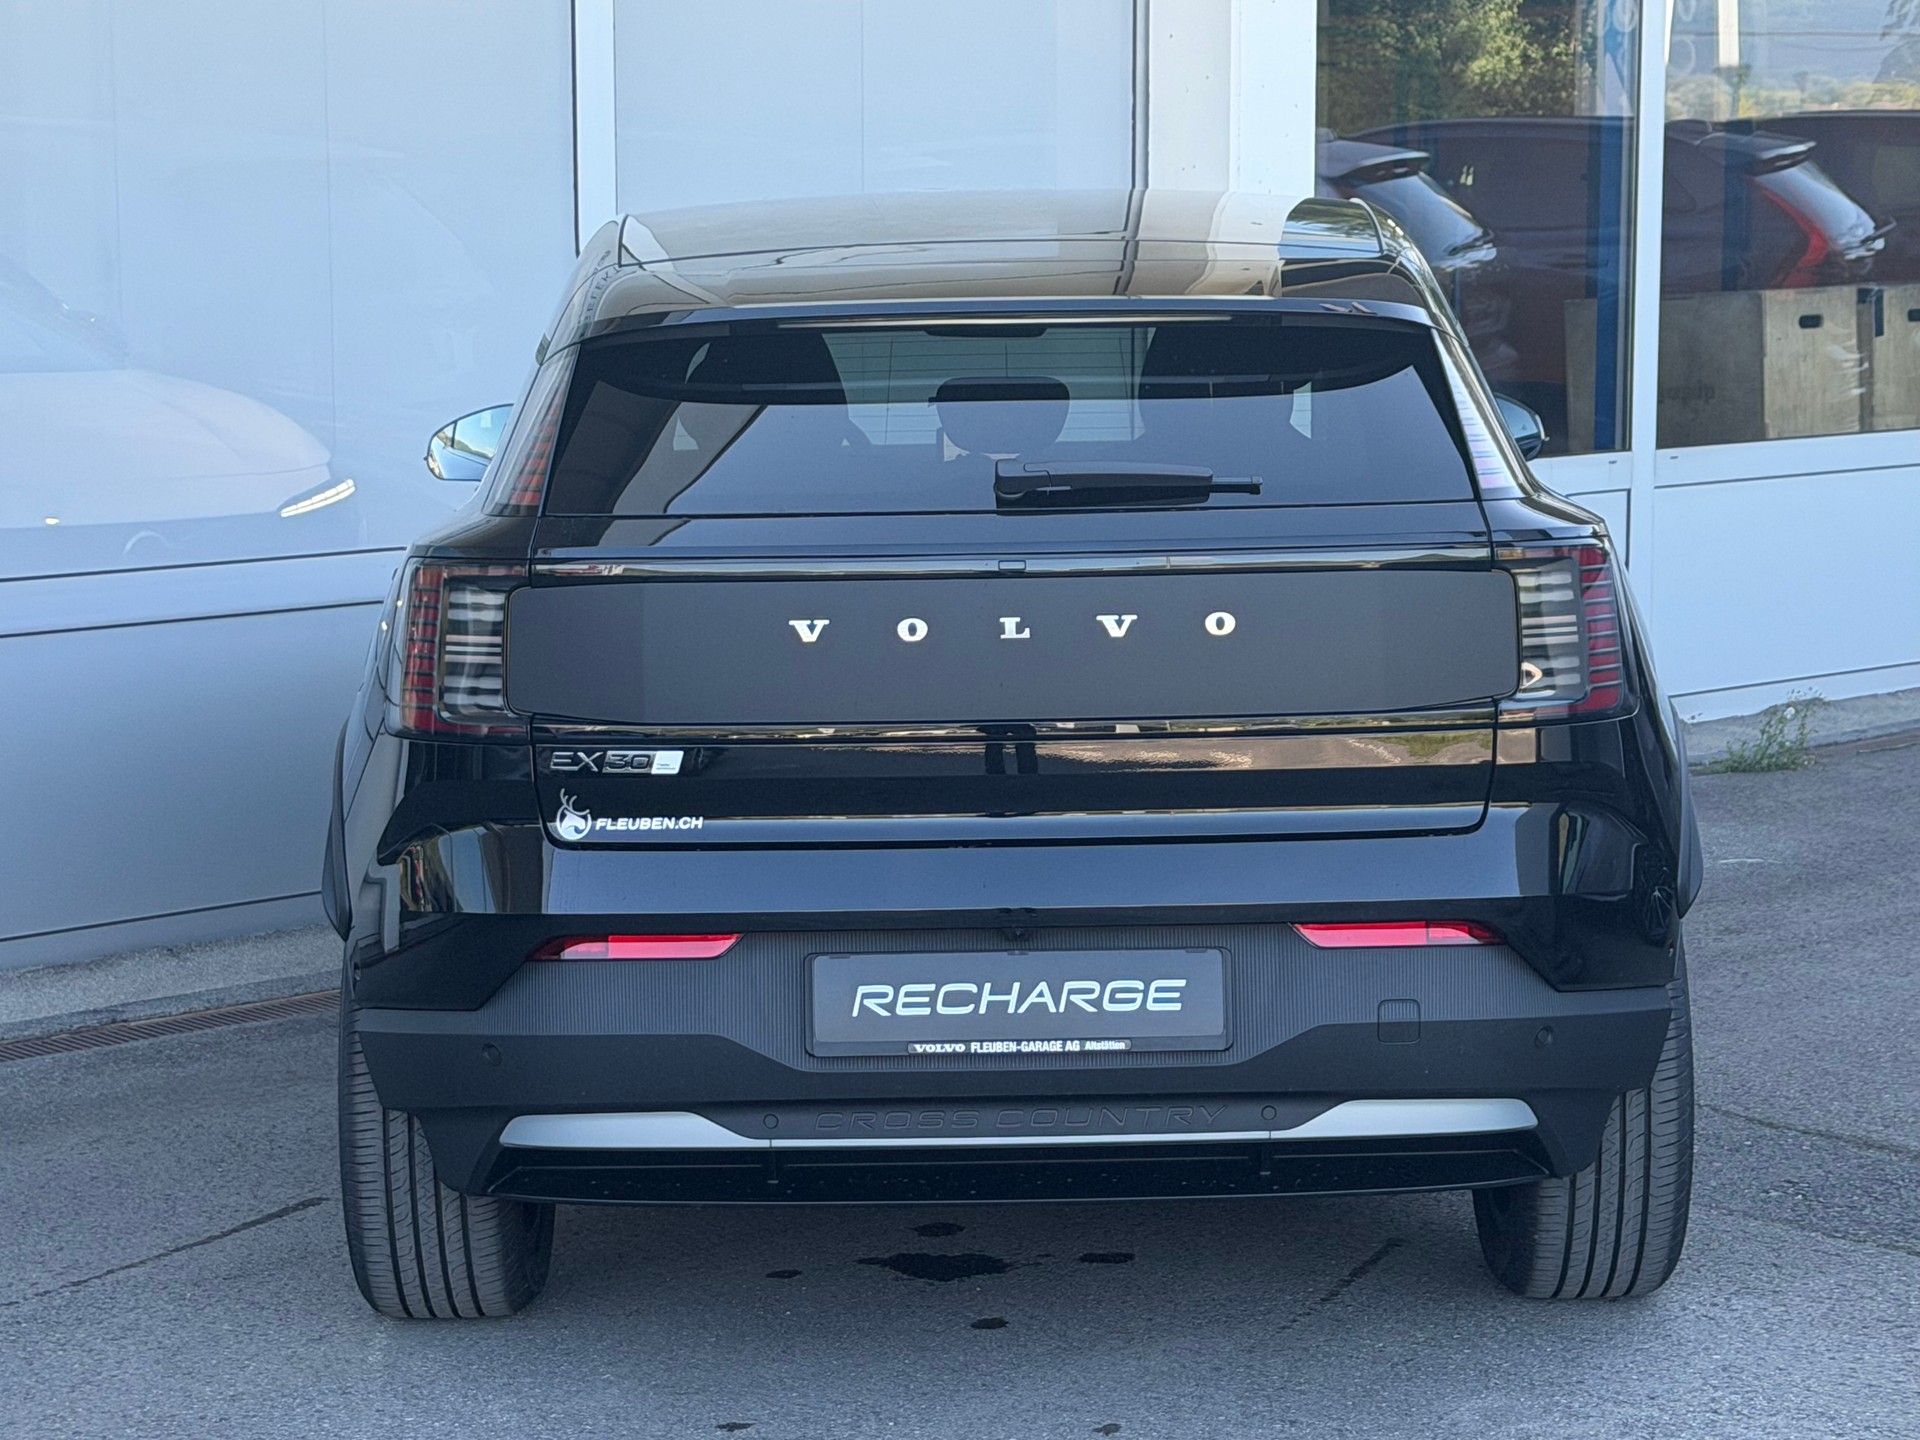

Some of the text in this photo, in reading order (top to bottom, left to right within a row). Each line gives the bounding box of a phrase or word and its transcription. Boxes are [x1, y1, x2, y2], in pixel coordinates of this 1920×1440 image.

[788, 611, 1237, 643] VOLVO
[550, 750, 652, 774] EX30
[595, 816, 704, 831] FLEUBEN.CH
[851, 978, 1188, 1018] RECHARGE
[913, 1043, 966, 1053] VOLVO
[970, 1040, 1063, 1054] FLEUBEN-GARAGE
[1064, 1040, 1081, 1052] AG
[815, 1106, 1228, 1131] CROSS COUNTRY
